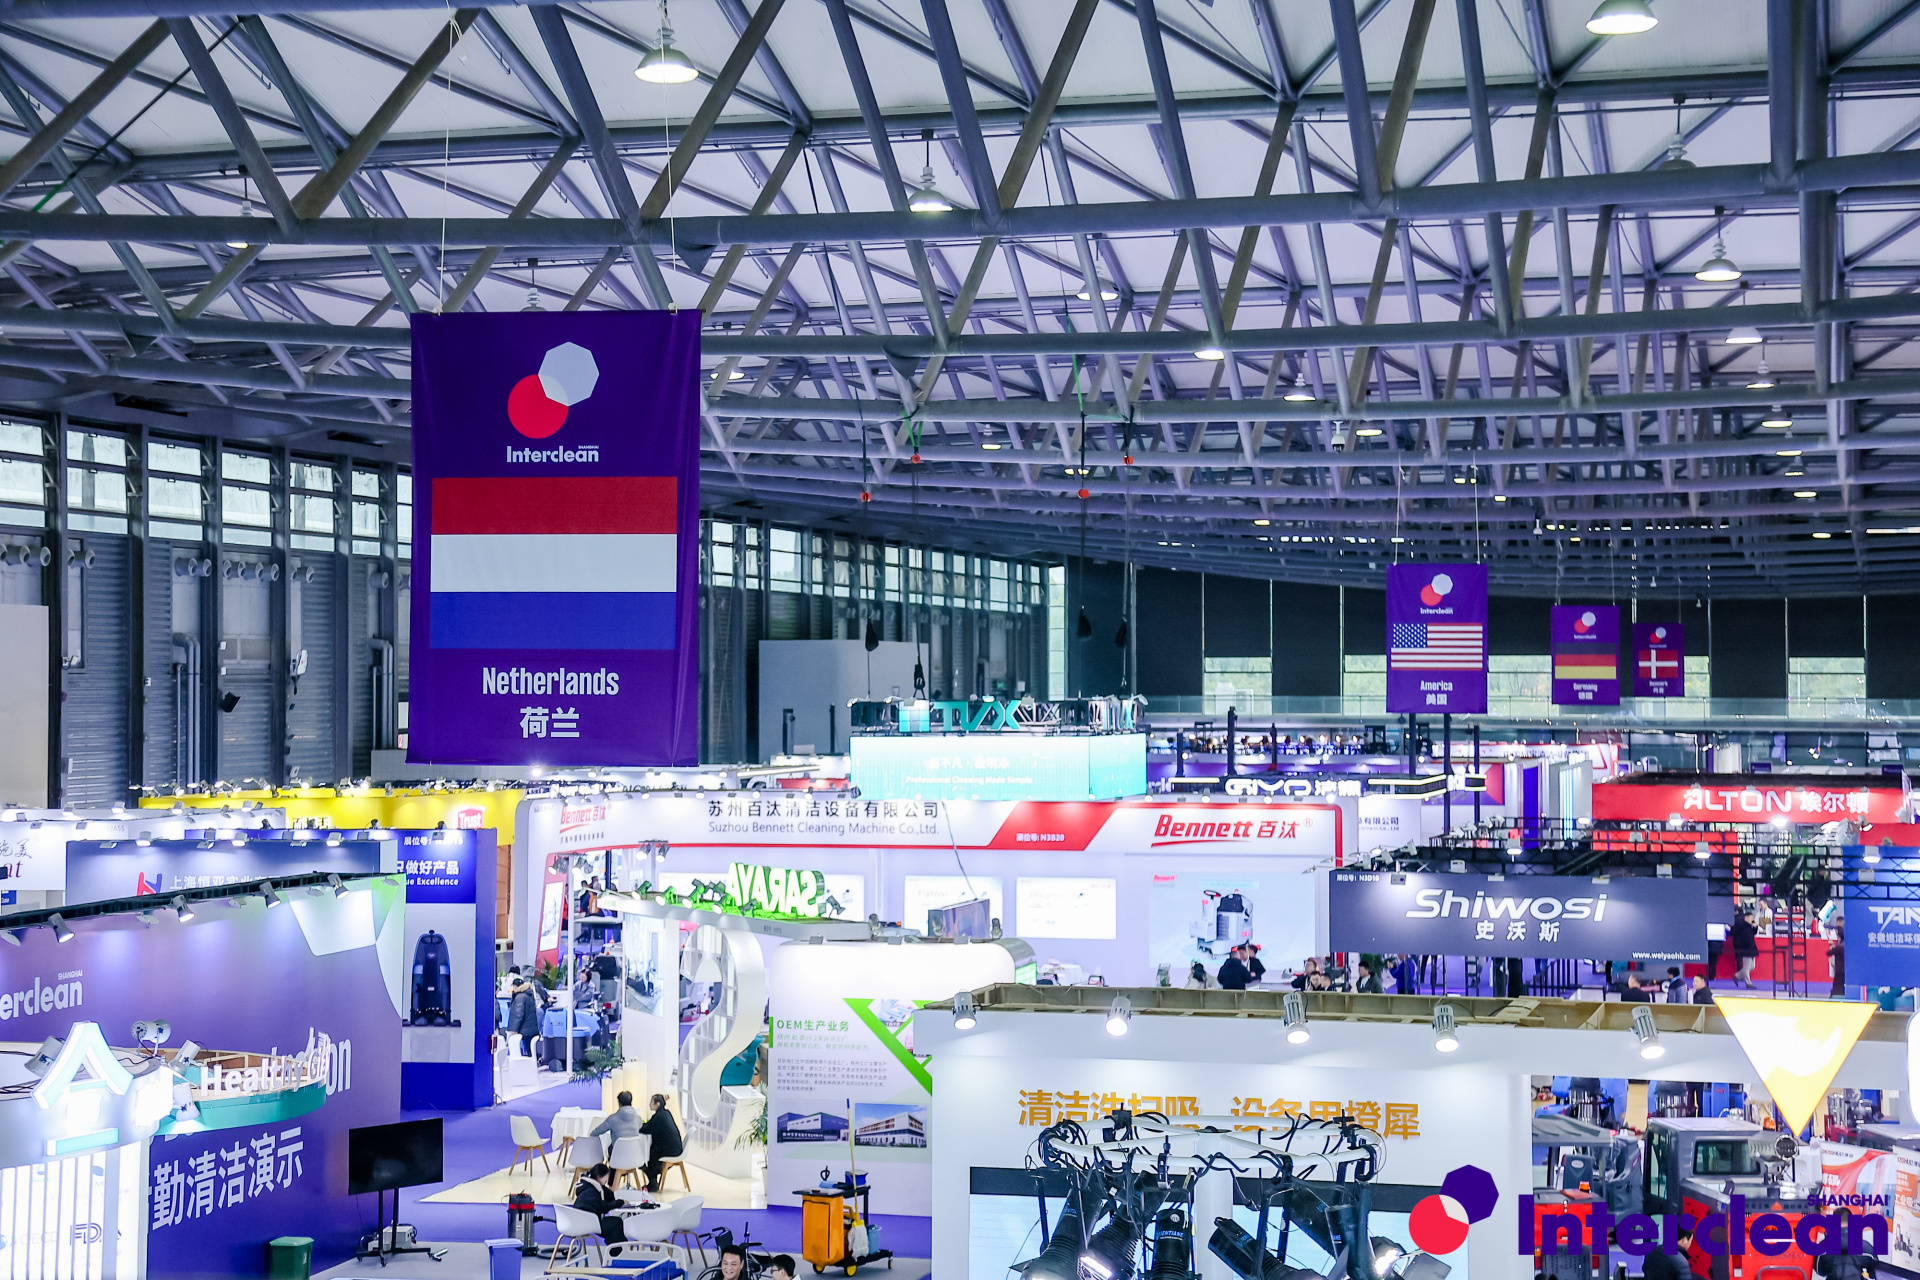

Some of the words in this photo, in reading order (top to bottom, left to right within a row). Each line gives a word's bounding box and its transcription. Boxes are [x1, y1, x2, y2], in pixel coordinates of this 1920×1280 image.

[507, 446, 599, 462] Interclean
[482, 668, 619, 695] Netherlands
[1420, 681, 1453, 691] America
[1573, 683, 1597, 692] Germany
[1426, 694, 1447, 705] 美国
[520, 707, 579, 738] 荷兰
[952, 775, 984, 785] Cleaning
[985, 775, 1006, 783] Made
[1007, 775, 1033, 785] Simple
[708, 800, 939, 818] 苏州百汰清洁设备有限公司
[1683, 789, 1791, 812] ALTON
[1798, 791, 1869, 814] 埃尔顿
[459, 813, 482, 829] Trust
[561, 805, 592, 824] Bennett
[709, 821, 748, 833] Suzhou
[752, 822, 794, 833] Bennett
[797, 823, 844, 836] Cleaning
[848, 823, 895, 834] Machine
[1154, 815, 1253, 837] Bennett
[1257, 820, 1299, 838] 百汰
[416, 877, 459, 886] Excellence
[1405, 889, 1608, 922] Shiwosi
[1475, 920, 1560, 943] 史沃斯
[58, 969, 83, 981] SHANGHAI
[777, 1019, 849, 1031] OEM生产业务
[201, 1055, 303, 1096] Healthy
